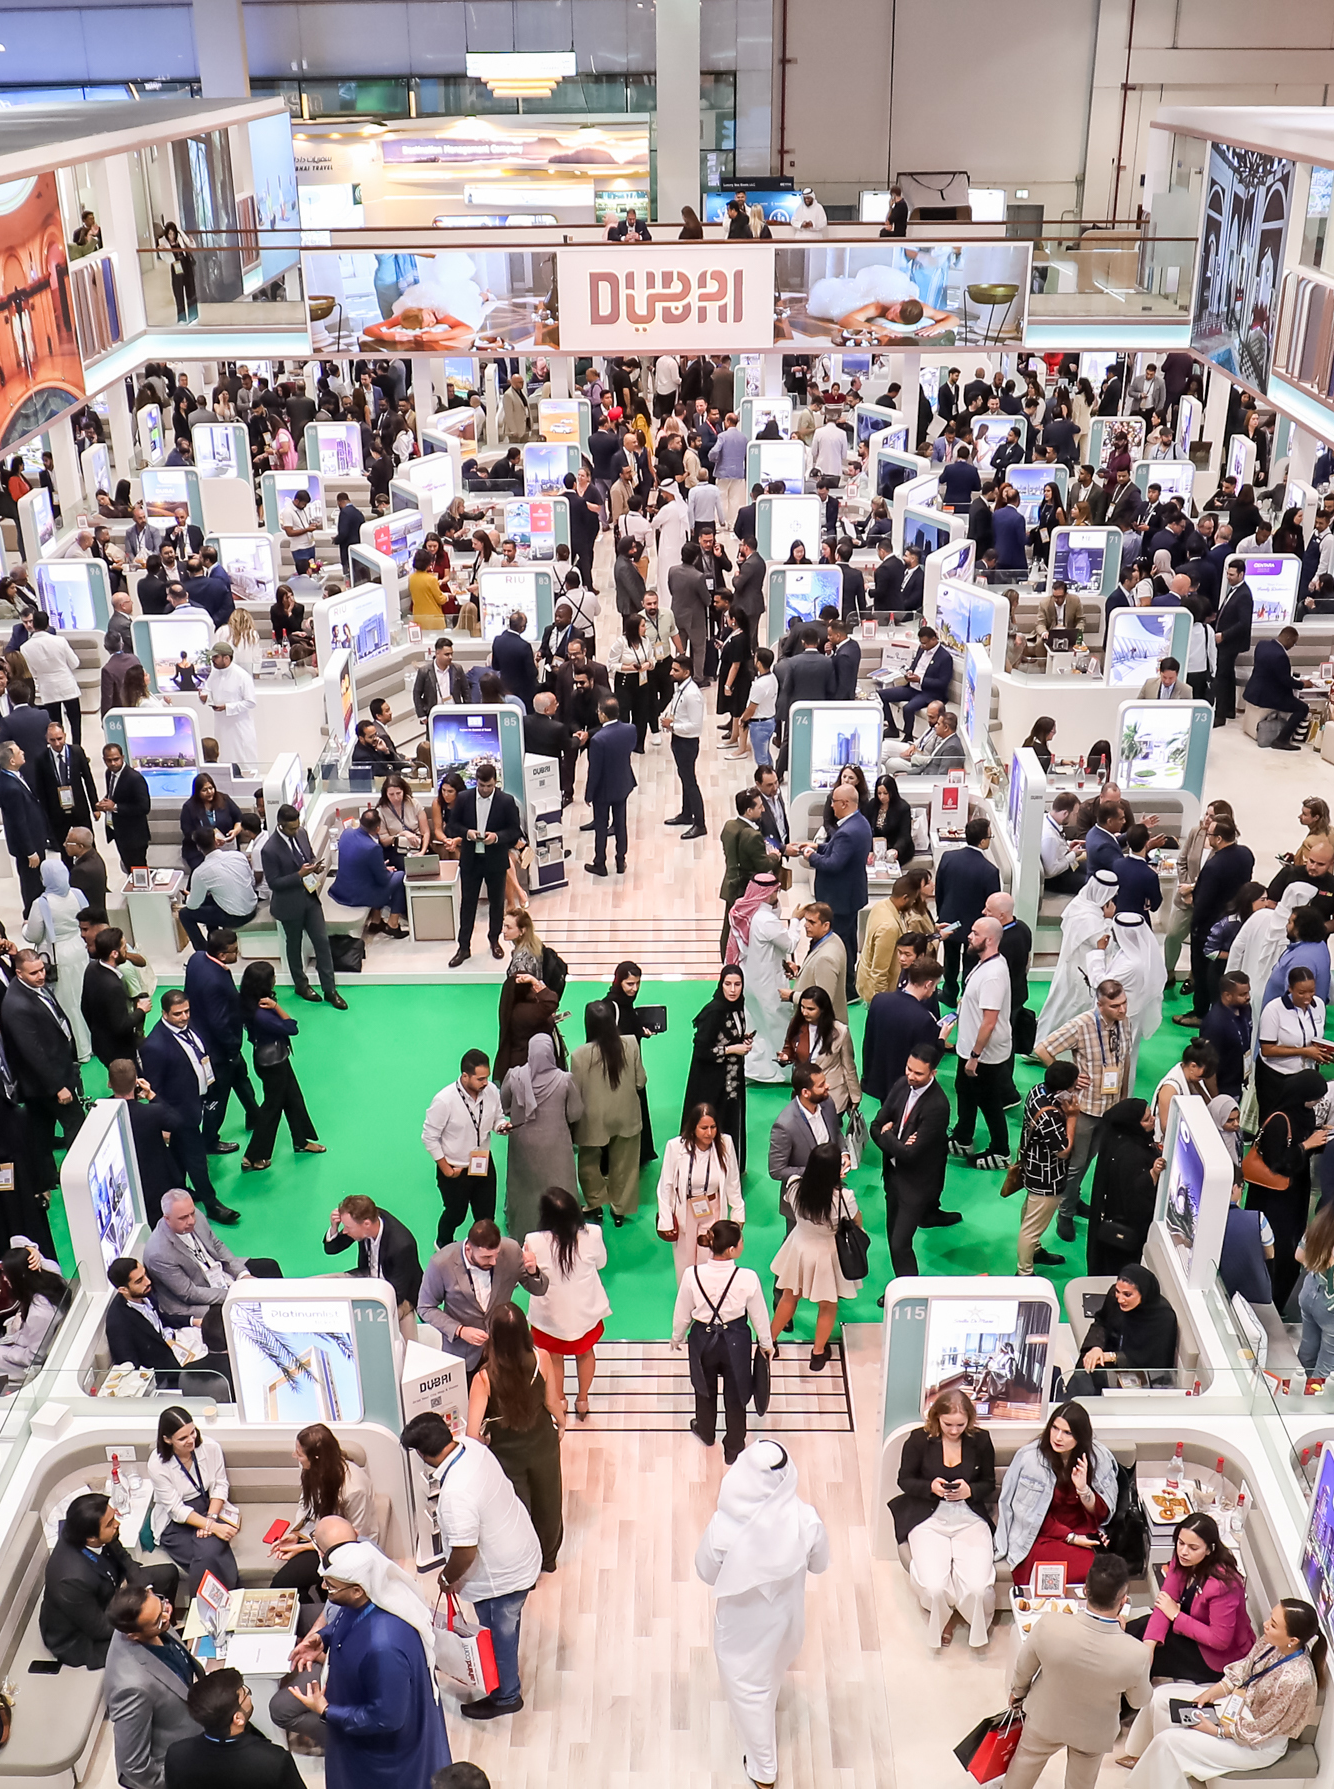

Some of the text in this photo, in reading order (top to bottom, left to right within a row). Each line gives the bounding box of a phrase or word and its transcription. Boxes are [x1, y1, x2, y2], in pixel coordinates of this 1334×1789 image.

[587, 269, 746, 334] DUBAI
[759, 503, 769, 511] 77
[1109, 535, 1118, 544] 71
[89, 567, 101, 576] 96
[505, 575, 526, 584] RIU
[538, 577, 549, 585] 83
[771, 575, 783, 583] 76
[503, 717, 517, 727] 85
[795, 715, 809, 725] 74
[1194, 712, 1207, 722] 73
[109, 721, 122, 731] 86
[271, 1309, 339, 1319] Platinumlist
[354, 1307, 388, 1322] 112
[892, 1305, 926, 1320] 115
[419, 1372, 452, 1393] DUBAI
